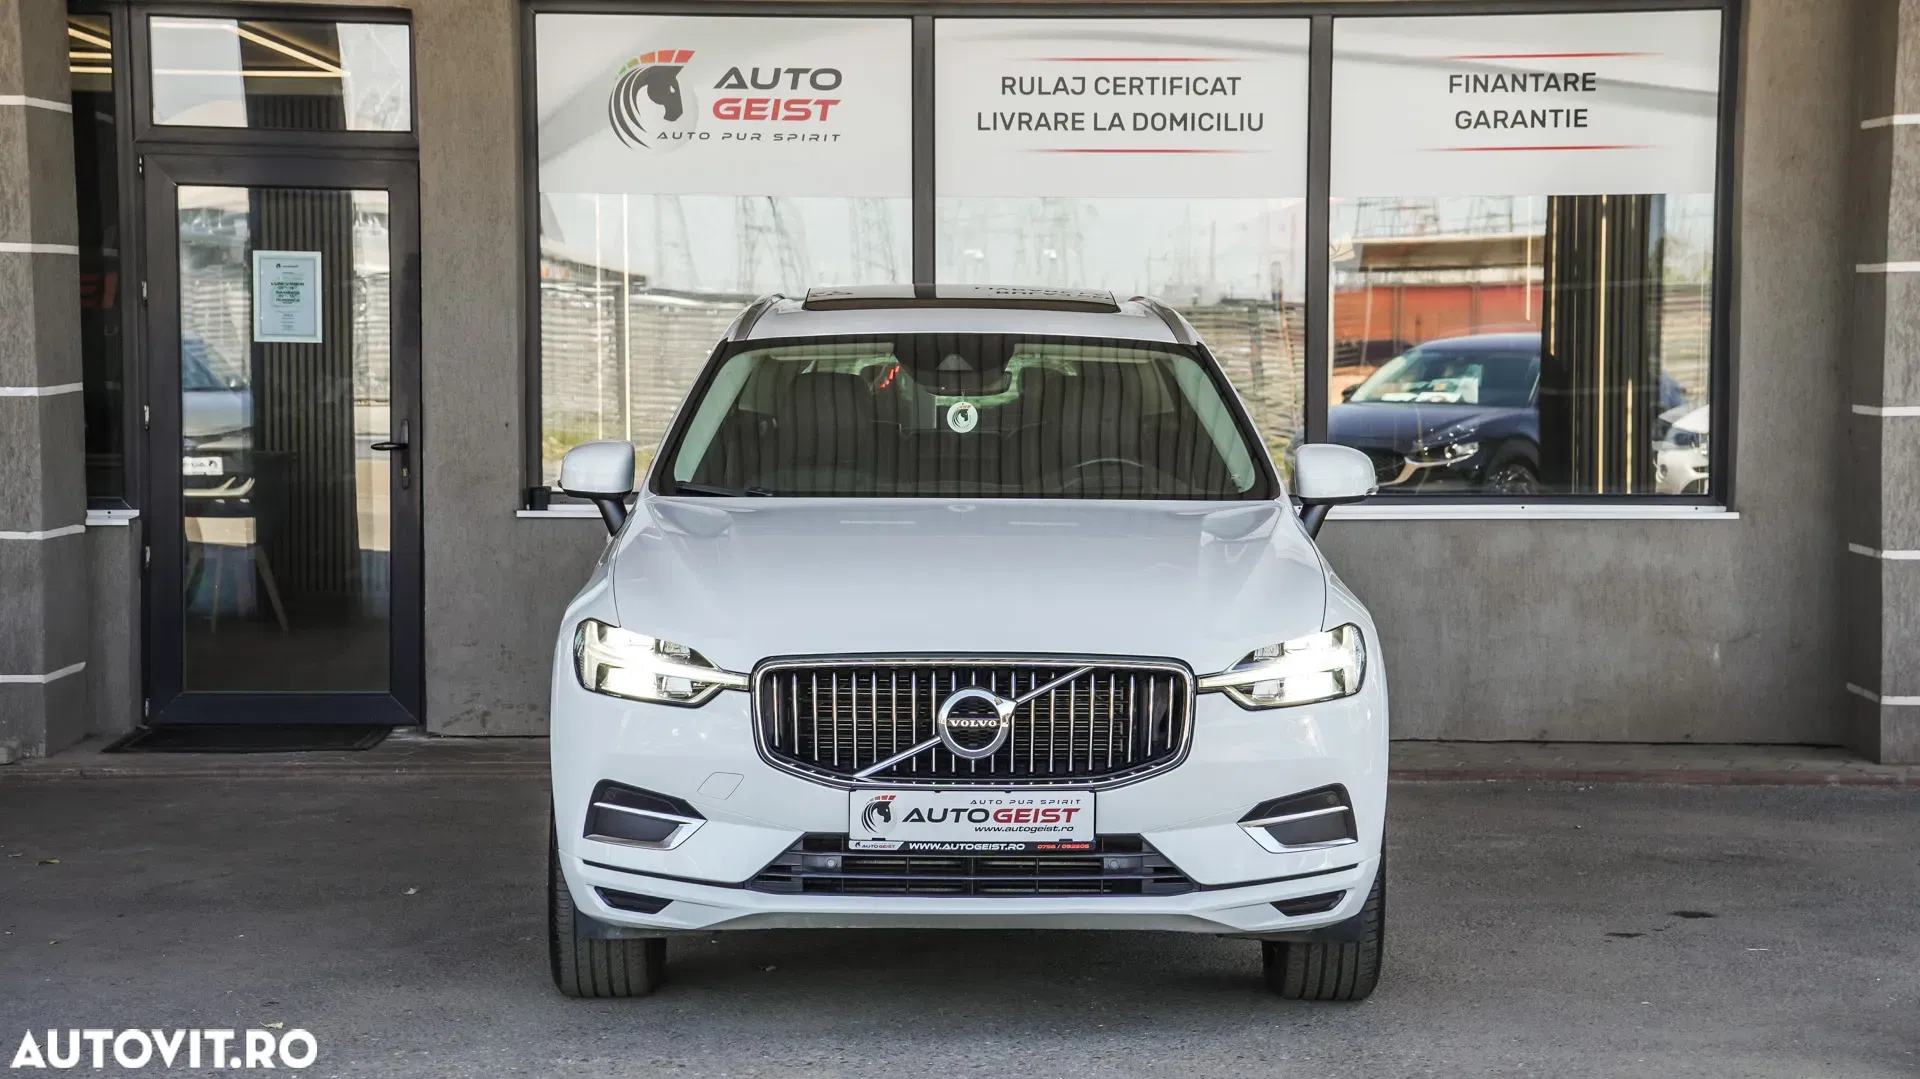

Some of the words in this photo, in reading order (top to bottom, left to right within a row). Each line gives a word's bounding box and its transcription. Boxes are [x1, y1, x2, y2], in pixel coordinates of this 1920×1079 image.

[713, 66, 843, 91] AUTO
[1001, 76, 1086, 96] RULAJ
[1094, 76, 1242, 96] CERTIFICAT
[1449, 72, 1597, 94] FINANTARE
[712, 97, 842, 122] GEIST
[1454, 108, 1588, 130] GARANTIE
[977, 111, 1085, 132] LIVRARE
[1093, 112, 1126, 132] LA
[1132, 112, 1264, 132] DOMICILIU
[656, 131, 711, 141] AUTO
[721, 132, 762, 142] PUR
[773, 133, 841, 142] SPIRIT
[949, 719, 997, 727] VOLVO
[974, 825, 1075, 834] www.autogeist.ro
[908, 842, 1026, 851] WWW.AUTOGEIST.RO
